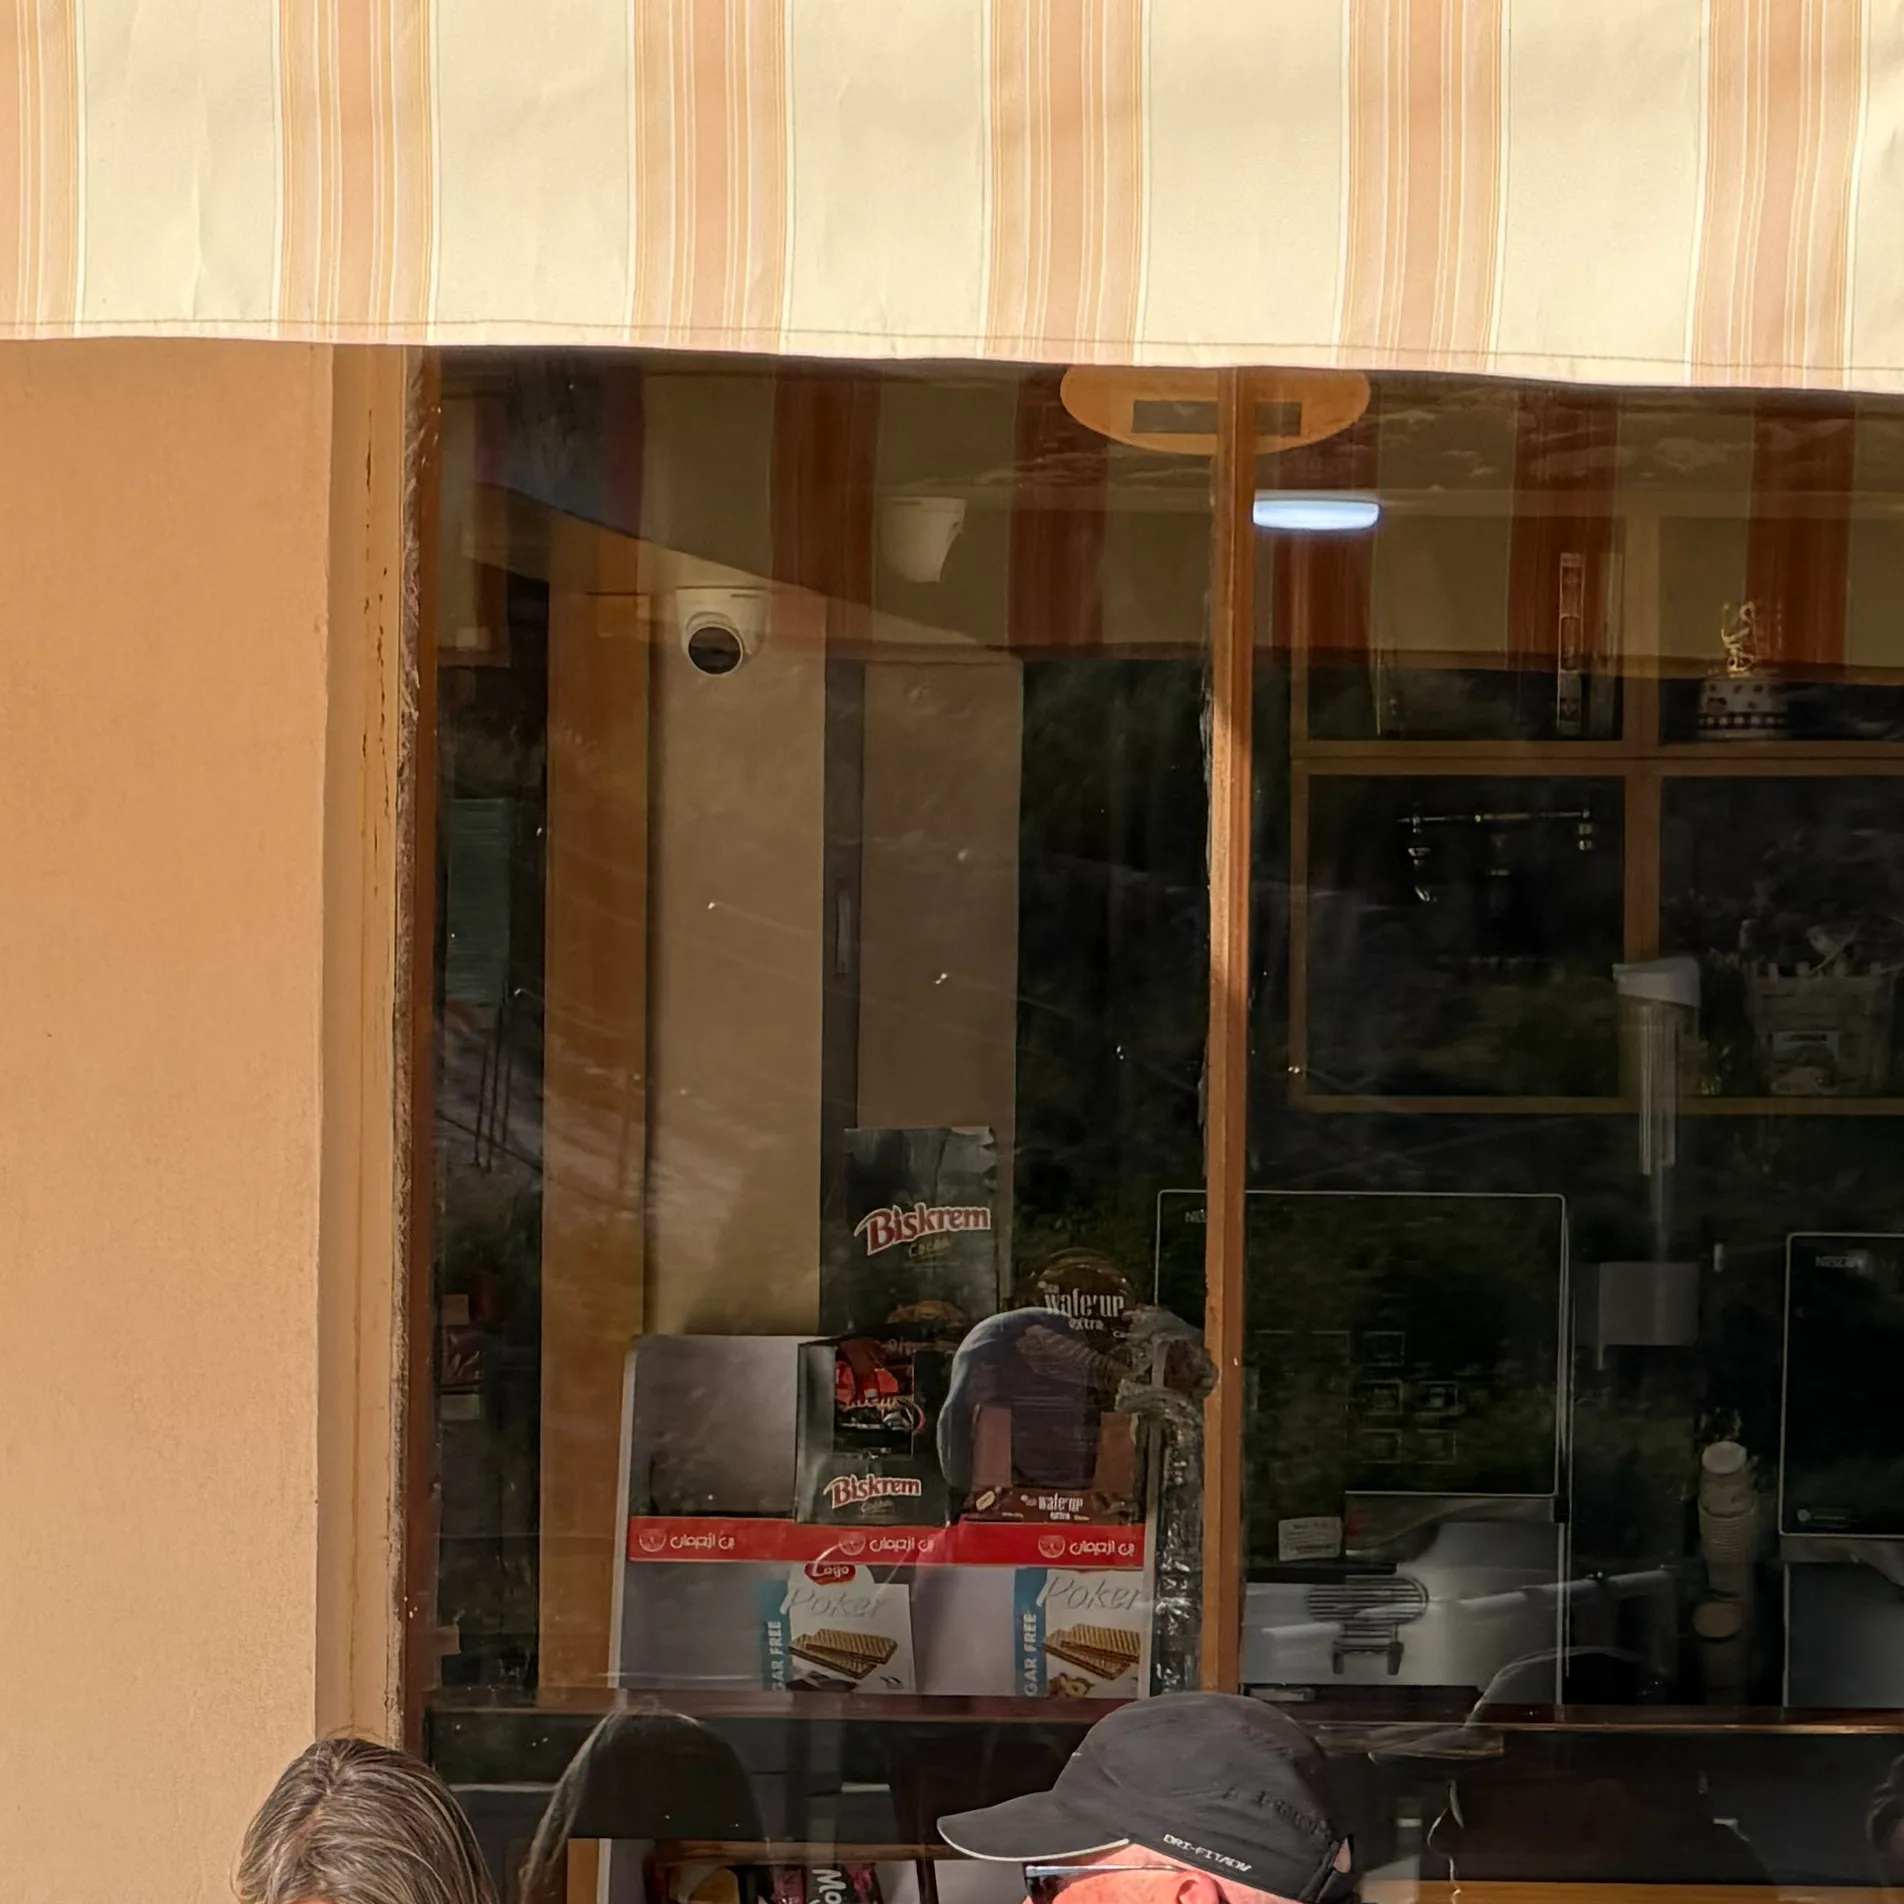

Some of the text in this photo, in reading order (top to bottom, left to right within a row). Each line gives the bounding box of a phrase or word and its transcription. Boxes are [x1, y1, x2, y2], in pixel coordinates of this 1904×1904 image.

[854, 1202, 991, 1257] Biskrem
[823, 1474, 922, 1510] Biskrem
[779, 1583, 886, 1618] Poker
[1036, 1573, 1147, 1611] Poker
[769, 1620, 782, 1653] FREE
[1024, 1612, 1037, 1697] GAR FREE
